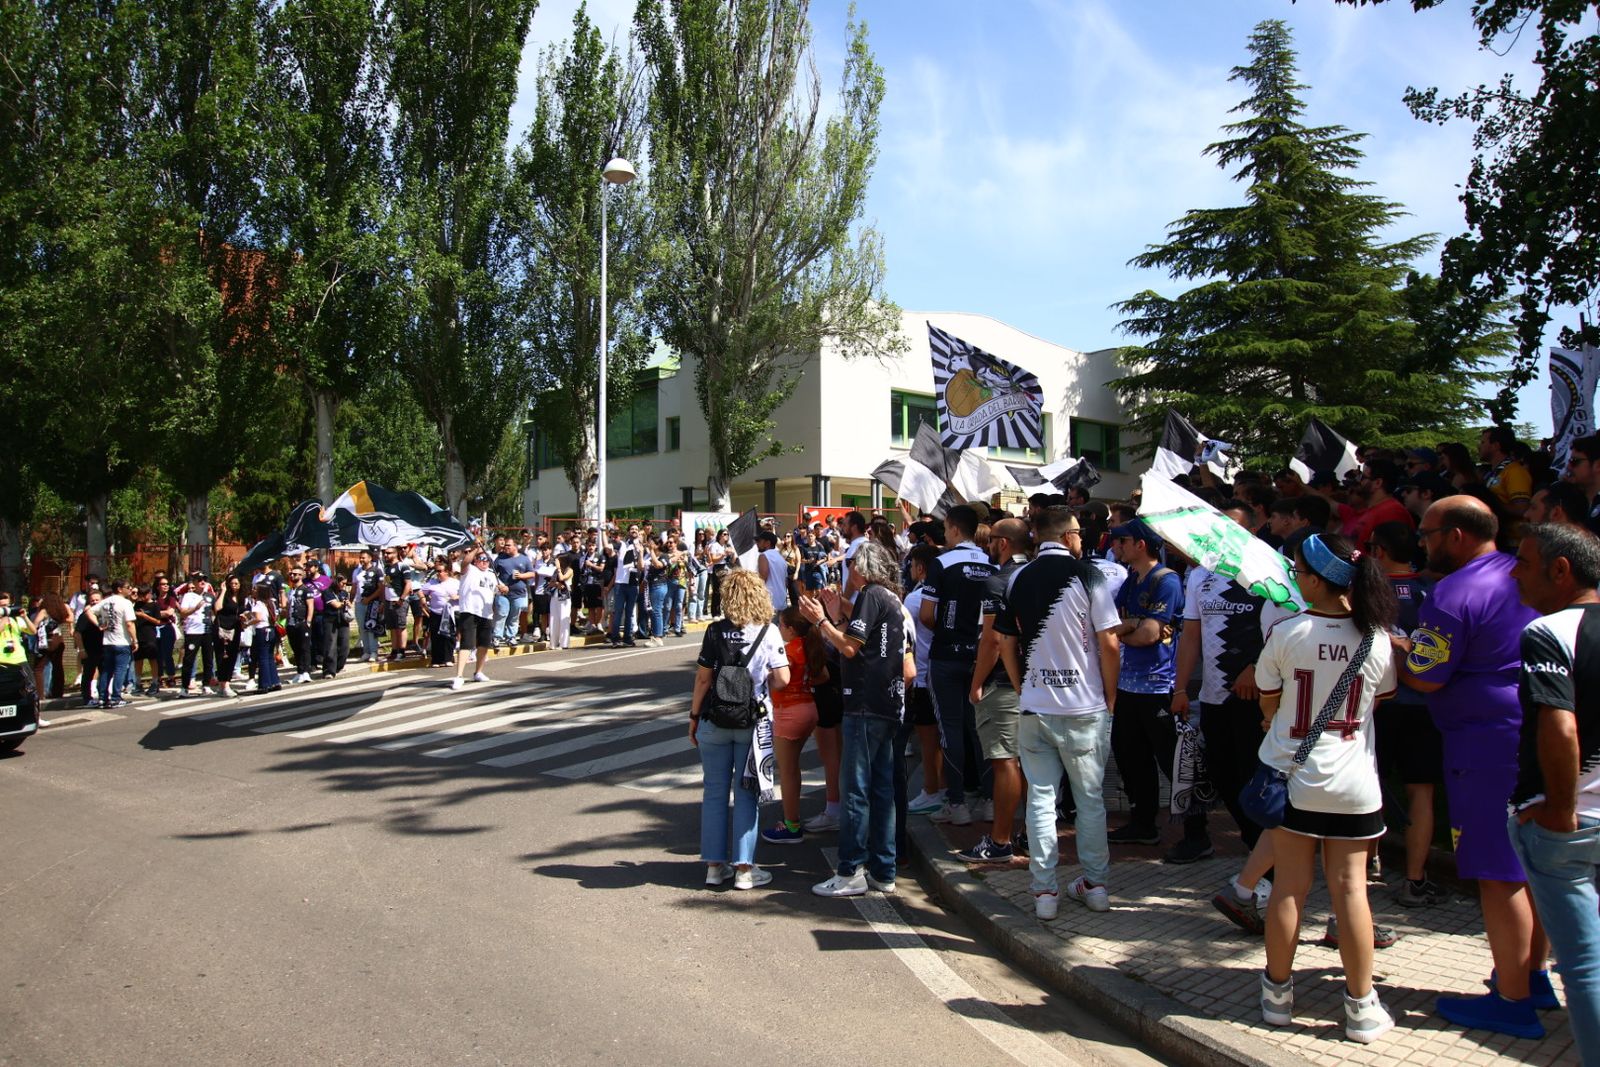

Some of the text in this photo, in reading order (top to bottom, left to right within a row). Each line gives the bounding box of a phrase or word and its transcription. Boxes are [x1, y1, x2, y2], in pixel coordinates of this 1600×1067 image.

[955, 420, 965, 430] LA
[967, 409, 987, 429] GRADA
[988, 402, 1002, 415] DEL
[1202, 600, 1254, 613] telefurgo
[1318, 643, 1349, 662] EVA
[1040, 668, 1080, 677] TERNERA
[1043, 677, 1079, 685] CHARRA
[1290, 667, 1364, 740] 14
